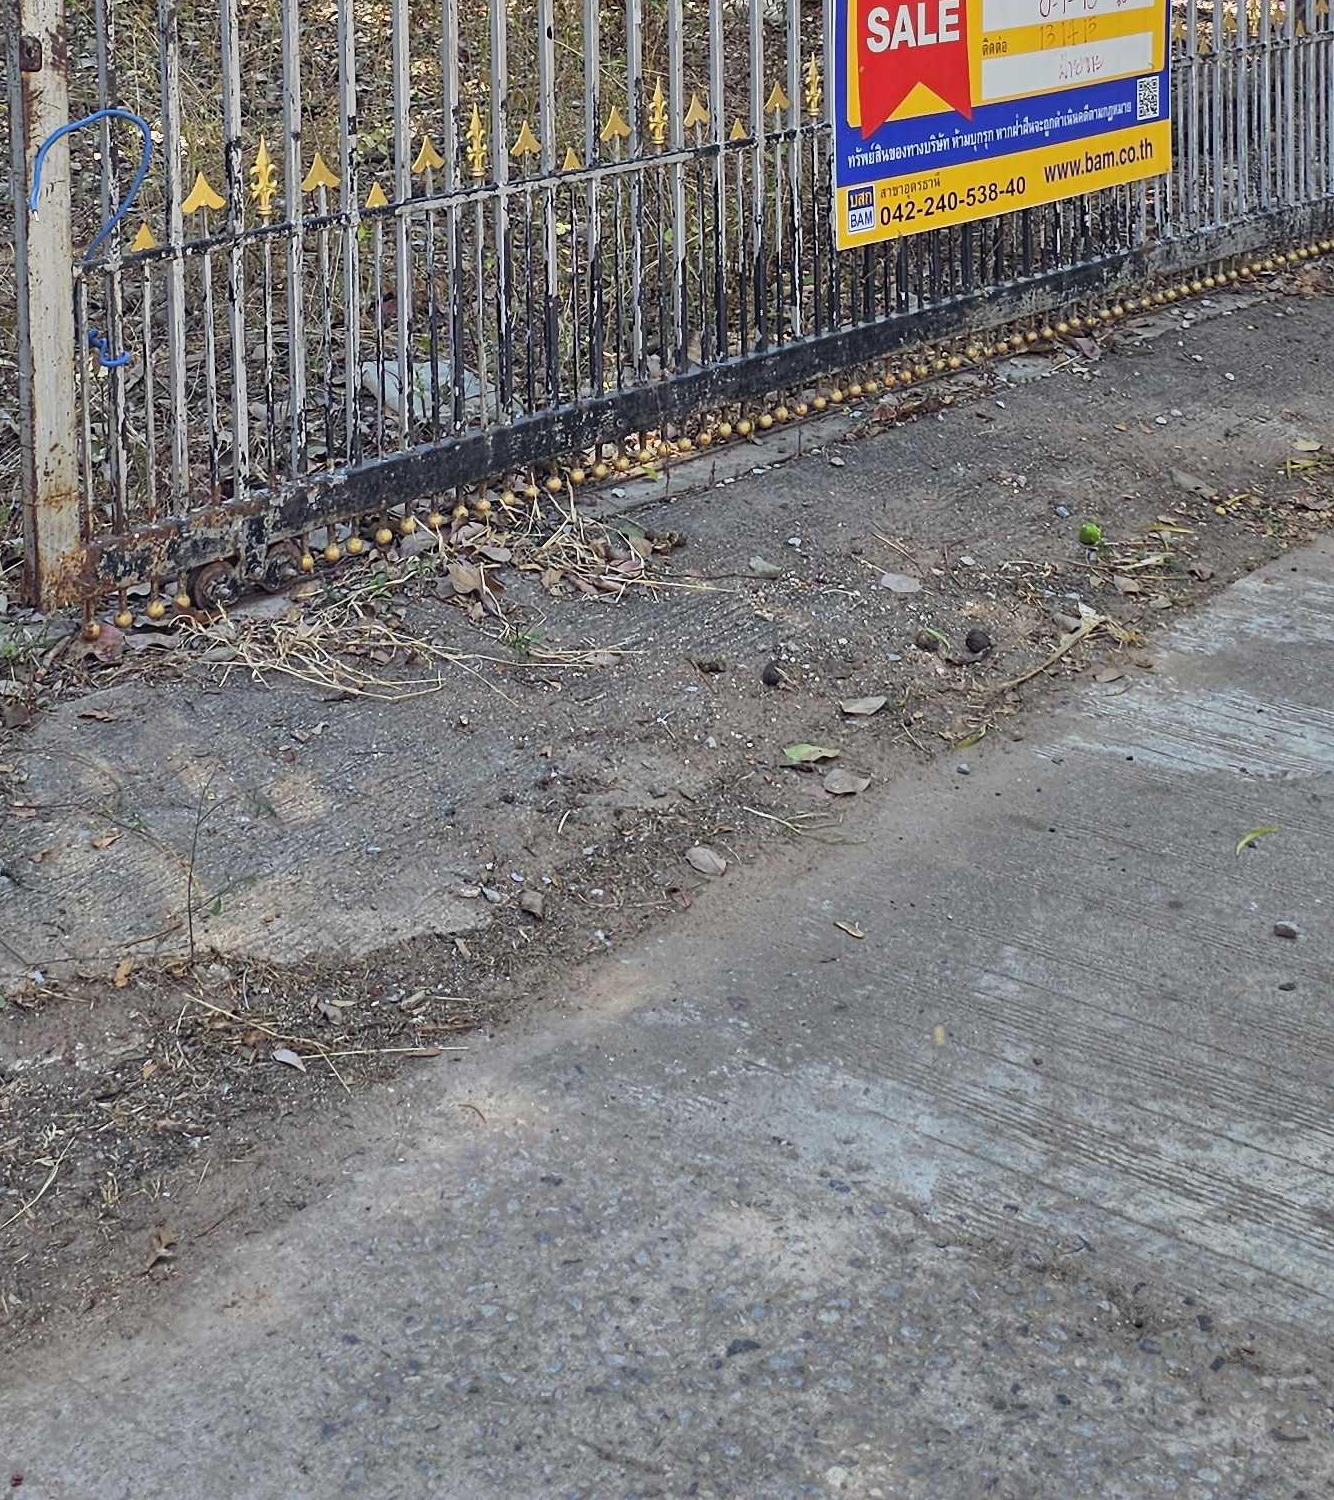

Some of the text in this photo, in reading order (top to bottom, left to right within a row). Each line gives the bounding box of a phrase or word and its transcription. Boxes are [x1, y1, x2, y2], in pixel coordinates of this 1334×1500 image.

[982, 36, 1007, 56] ติดต่อ
[847, 132, 949, 168] ทรัพย์สินของทางบริษัท
[952, 128, 993, 152] ห้ามบุกรุก
[1044, 137, 1153, 183] www.bam.co.th
[880, 172, 941, 199] สาขาอุดรธานี
[880, 176, 1026, 226] 042-240-538-40
[850, 210, 873, 228] BAM
